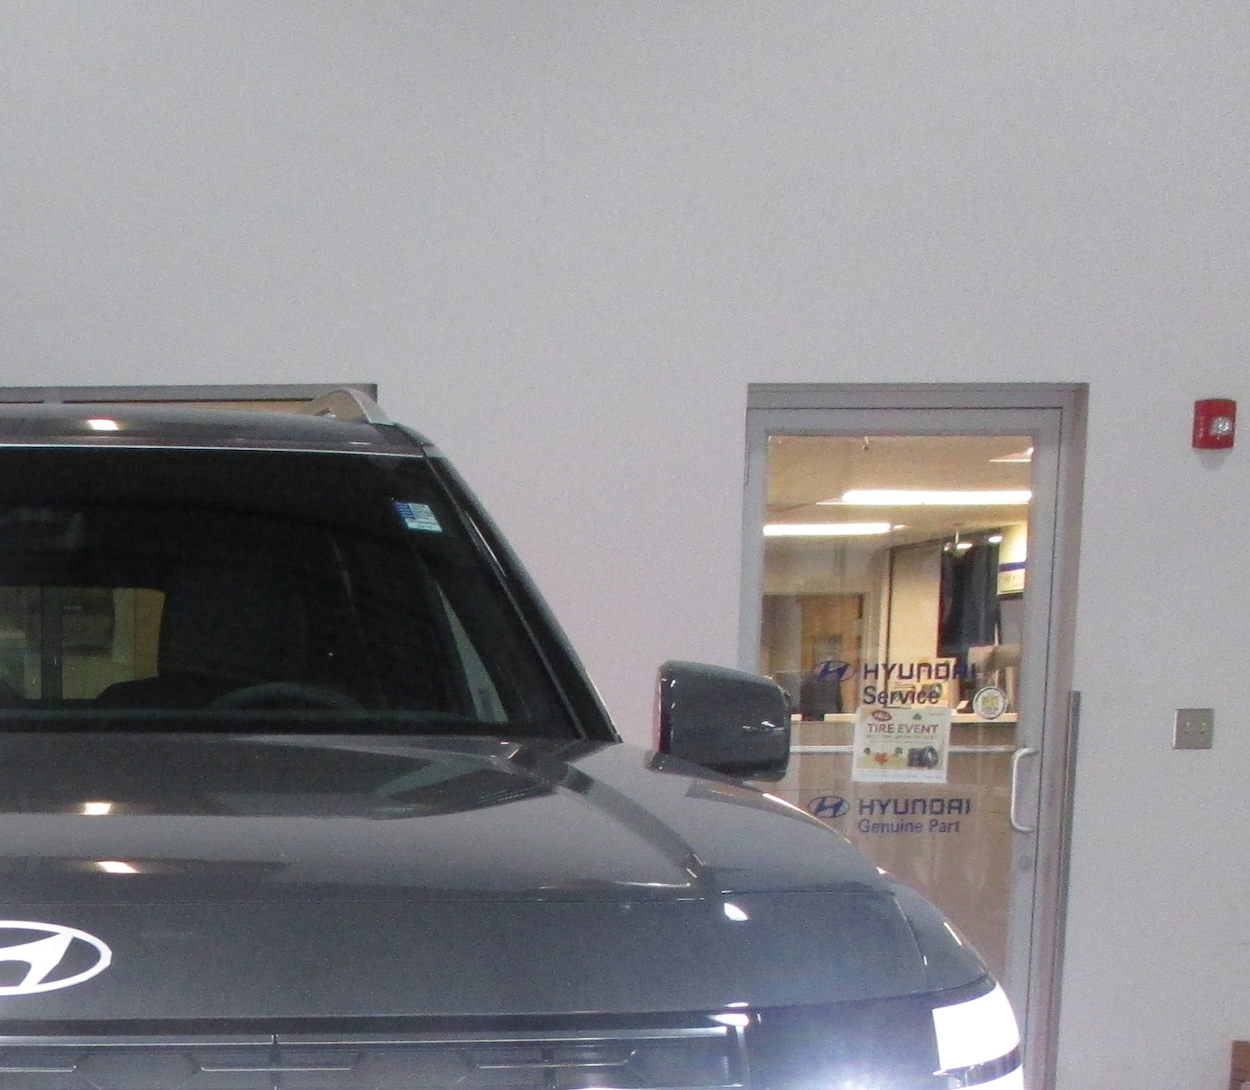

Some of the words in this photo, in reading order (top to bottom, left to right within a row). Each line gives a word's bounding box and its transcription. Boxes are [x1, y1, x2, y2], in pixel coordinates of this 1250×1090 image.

[863, 662, 977, 681] HYUNDAI
[862, 685, 939, 705] Service
[867, 723, 894, 734] TIRE
[897, 723, 939, 734] EVENT
[858, 798, 972, 816] HYUNDAI
[858, 819, 923, 833] Genuine
[929, 819, 961, 833] Part
